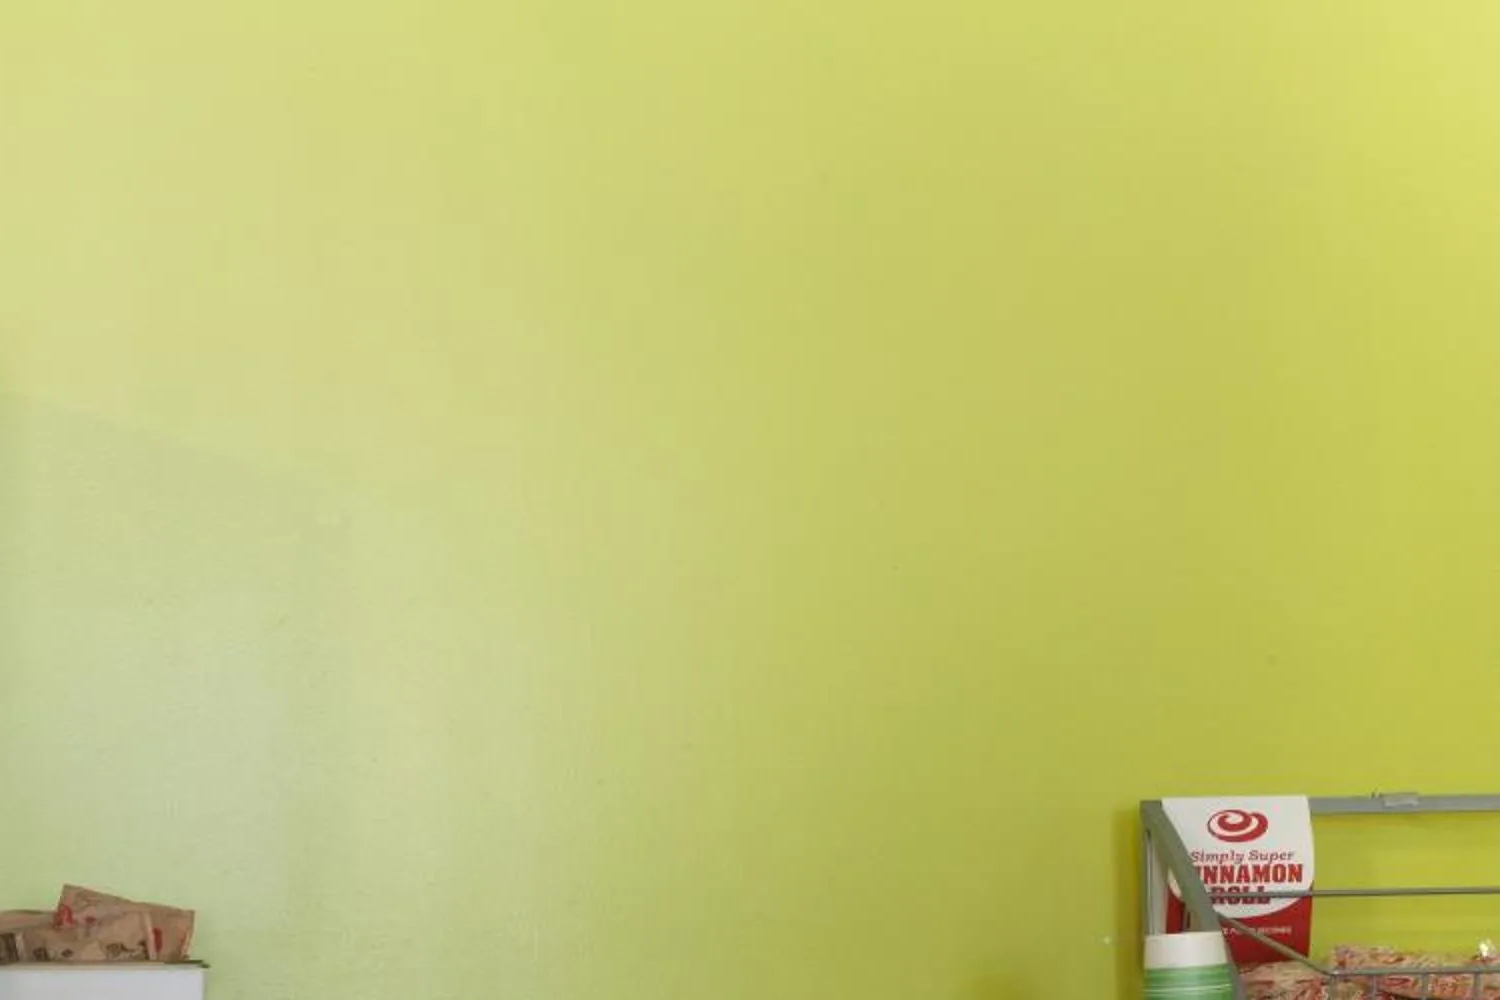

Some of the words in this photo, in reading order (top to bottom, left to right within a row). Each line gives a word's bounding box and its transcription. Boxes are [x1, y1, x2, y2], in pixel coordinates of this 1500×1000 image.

[1191, 850, 1244, 864] Simply
[1248, 850, 1295, 863] Super
[1195, 864, 1303, 884] NNAMON
[1211, 886, 1270, 904] ROLL
